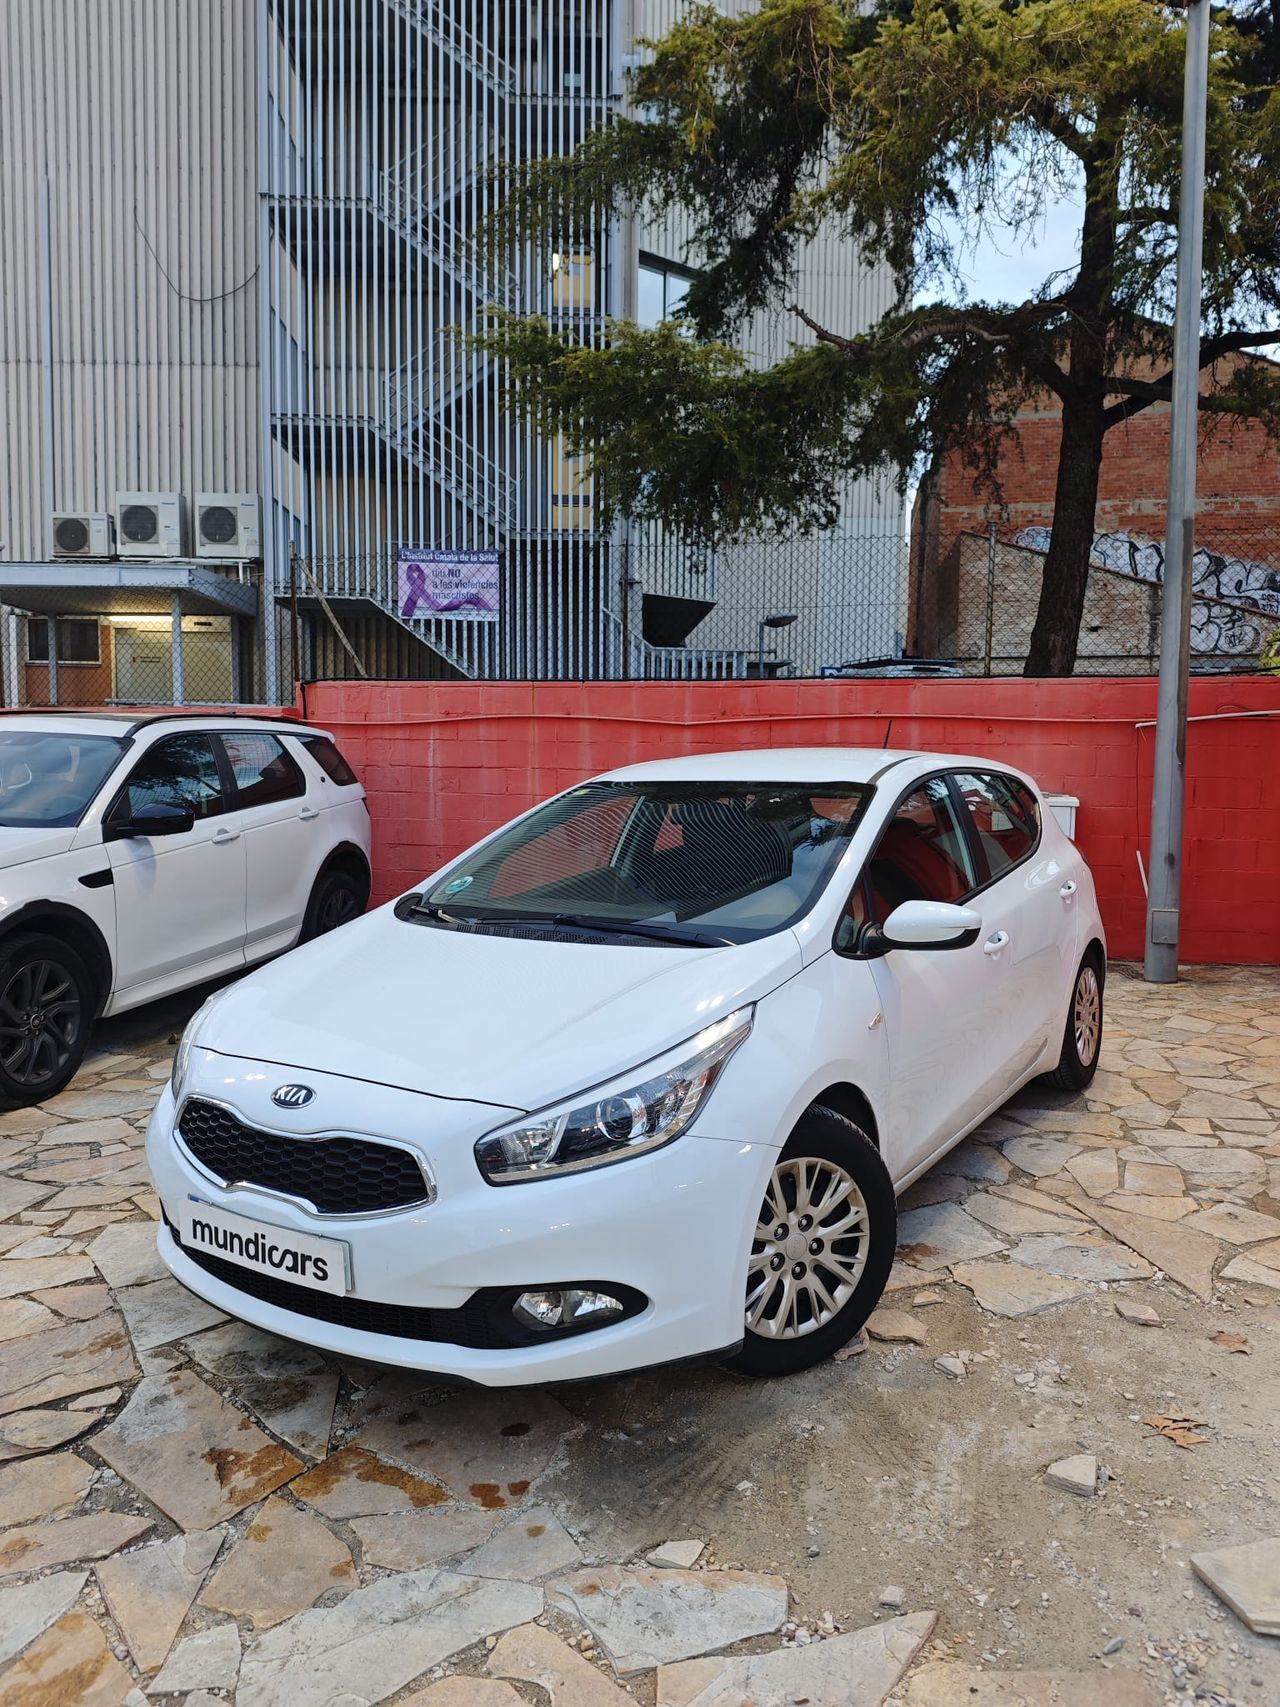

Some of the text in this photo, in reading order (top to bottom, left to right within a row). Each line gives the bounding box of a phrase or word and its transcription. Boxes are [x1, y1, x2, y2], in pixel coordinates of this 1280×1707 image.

[459, 553, 468, 561] de
[470, 553, 478, 561] la
[479, 553, 498, 562] Salut
[448, 569, 461, 578] NO
[432, 581, 438, 589] a
[440, 580, 453, 589] les
[275, 1086, 307, 1104] KIA
[192, 1218, 329, 1281] mundicars
